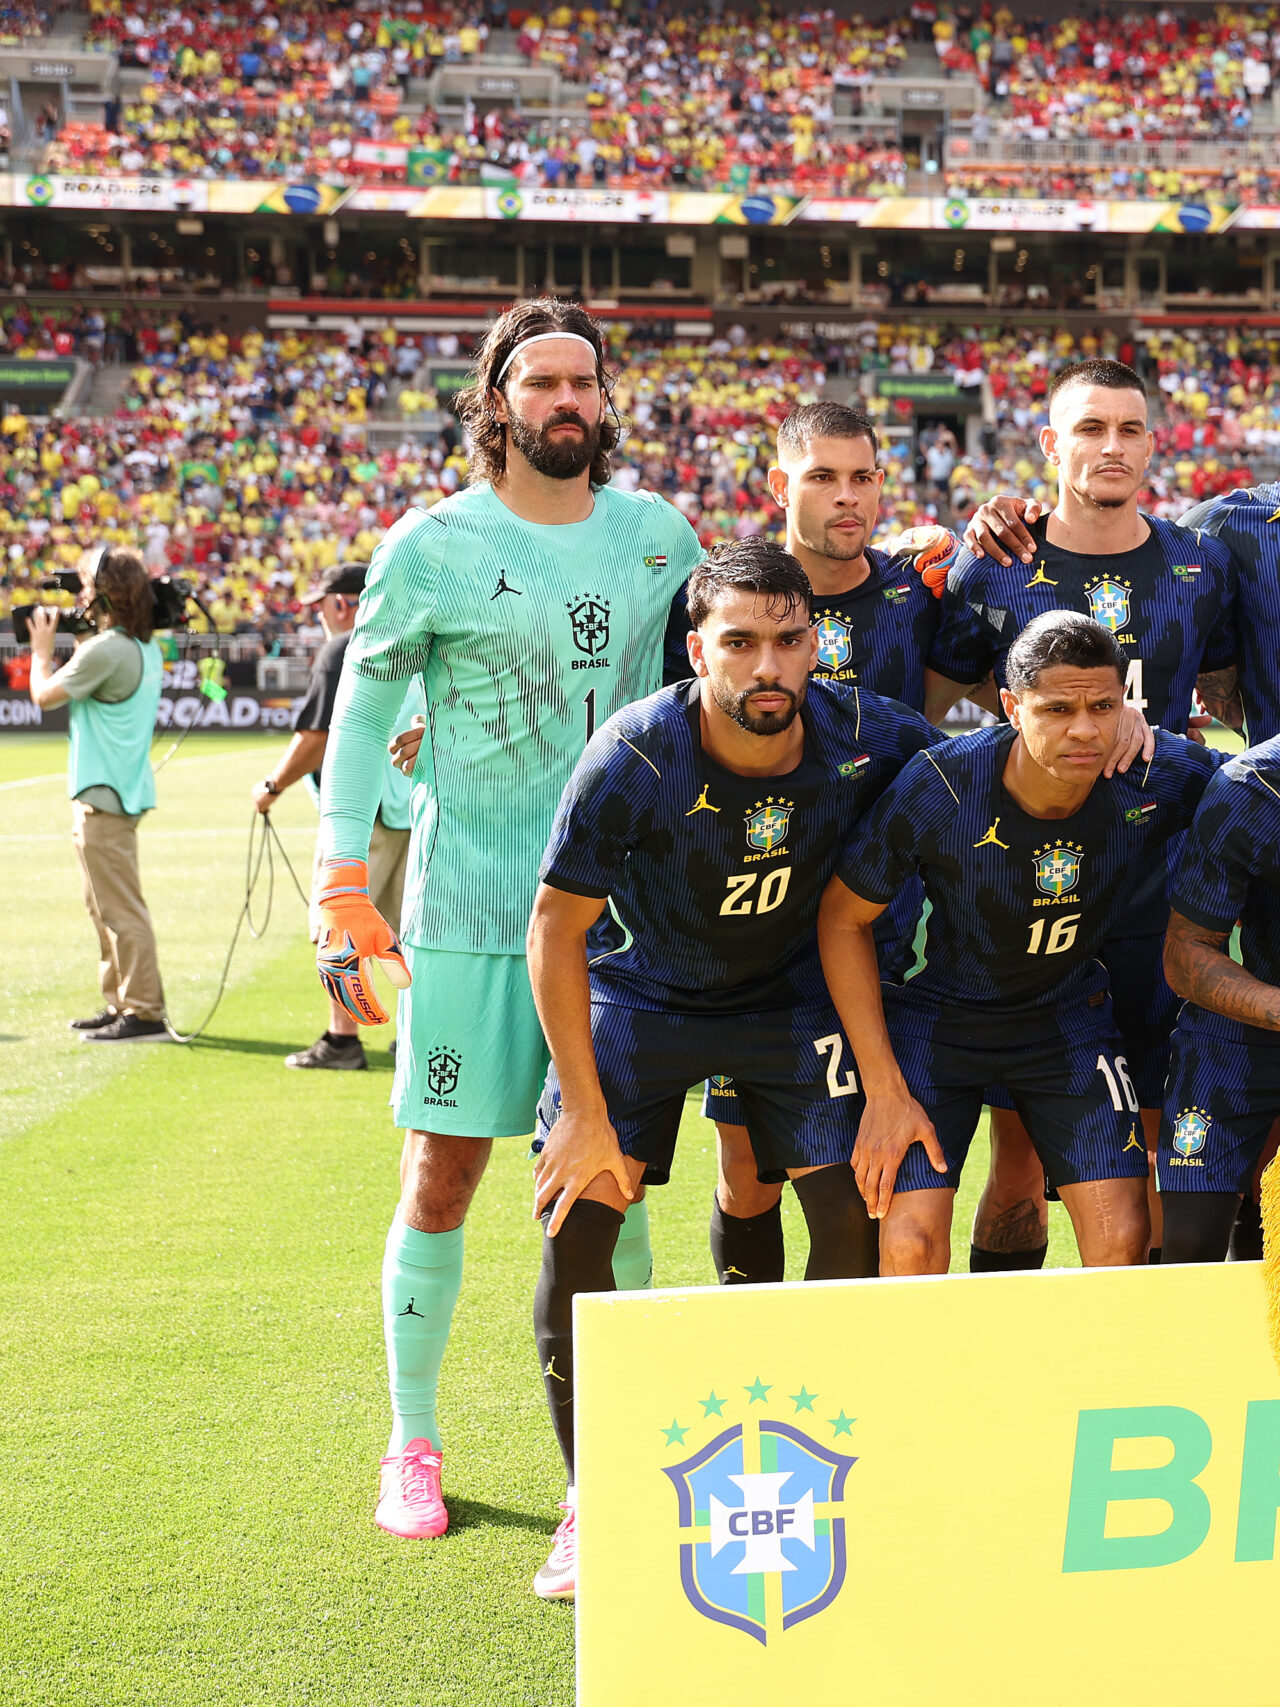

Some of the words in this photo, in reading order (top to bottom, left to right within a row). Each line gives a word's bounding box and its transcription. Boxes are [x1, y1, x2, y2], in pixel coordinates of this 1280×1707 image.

[923, 540, 954, 569] reus
[1101, 601, 1117, 609] CBF
[583, 622, 599, 631] CBF
[571, 658, 610, 670] BRASIL
[1123, 659, 1148, 714] 4
[583, 688, 596, 745] 1
[759, 822, 777, 831] CBF
[743, 847, 790, 863] BRASIL
[1049, 867, 1067, 875] CBF
[719, 866, 792, 916] 20
[1032, 894, 1081, 907] BRASIL
[1026, 913, 1081, 955] 16
[350, 976, 383, 1024] reusch
[813, 1033, 858, 1099] 2
[1096, 1054, 1140, 1113] 16
[710, 1087, 738, 1097] BRASIL
[424, 1096, 458, 1108] BRASIL
[1169, 1158, 1205, 1166] BRASIL
[728, 1508, 795, 1537] CBF
